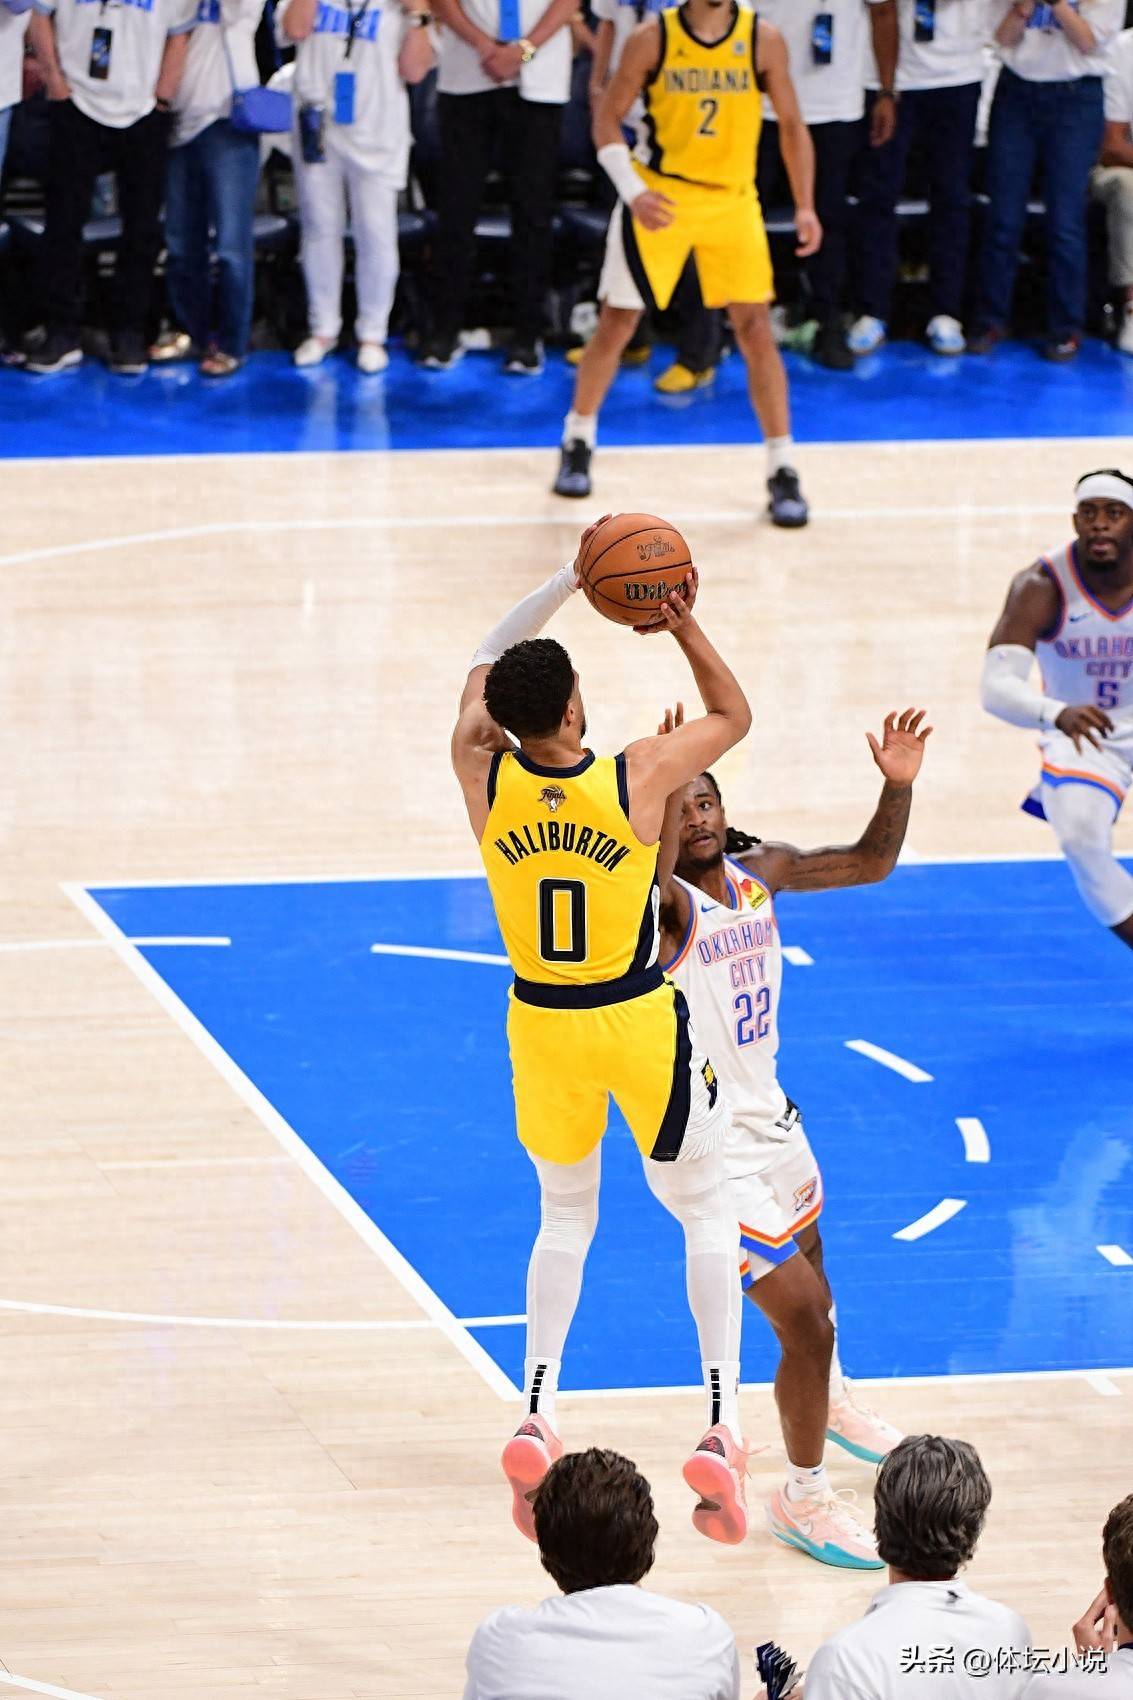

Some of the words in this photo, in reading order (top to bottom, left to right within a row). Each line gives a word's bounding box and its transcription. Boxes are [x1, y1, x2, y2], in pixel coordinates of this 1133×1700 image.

[665, 67, 749, 93] INDIANA
[698, 97, 719, 137] 2
[1086, 660, 1132, 679] CITY
[1097, 680, 1119, 709] 5
[494, 821, 631, 873] HALIBURTON
[537, 876, 588, 964] 0
[730, 953, 767, 990] CITY
[732, 984, 772, 1048] 22
